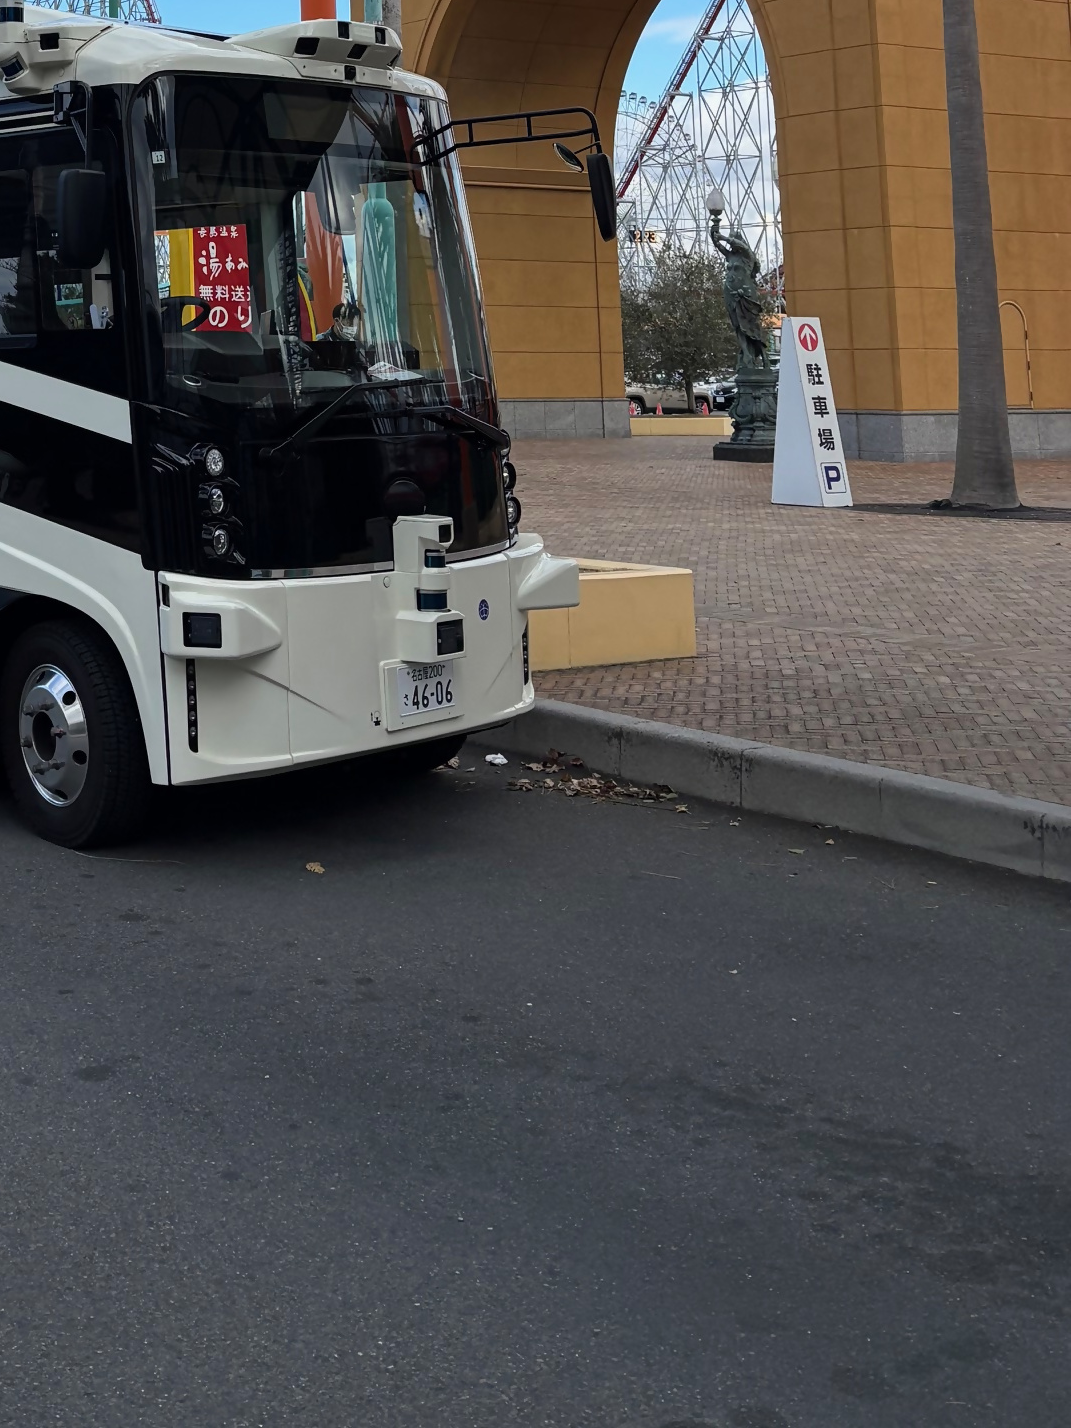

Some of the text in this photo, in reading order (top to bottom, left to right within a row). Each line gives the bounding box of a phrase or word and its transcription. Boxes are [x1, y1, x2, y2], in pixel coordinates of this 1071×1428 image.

[199, 284, 251, 302] 無料送
[805, 363, 841, 490] 駐車場 P
[412, 679, 454, 710] 46-06
